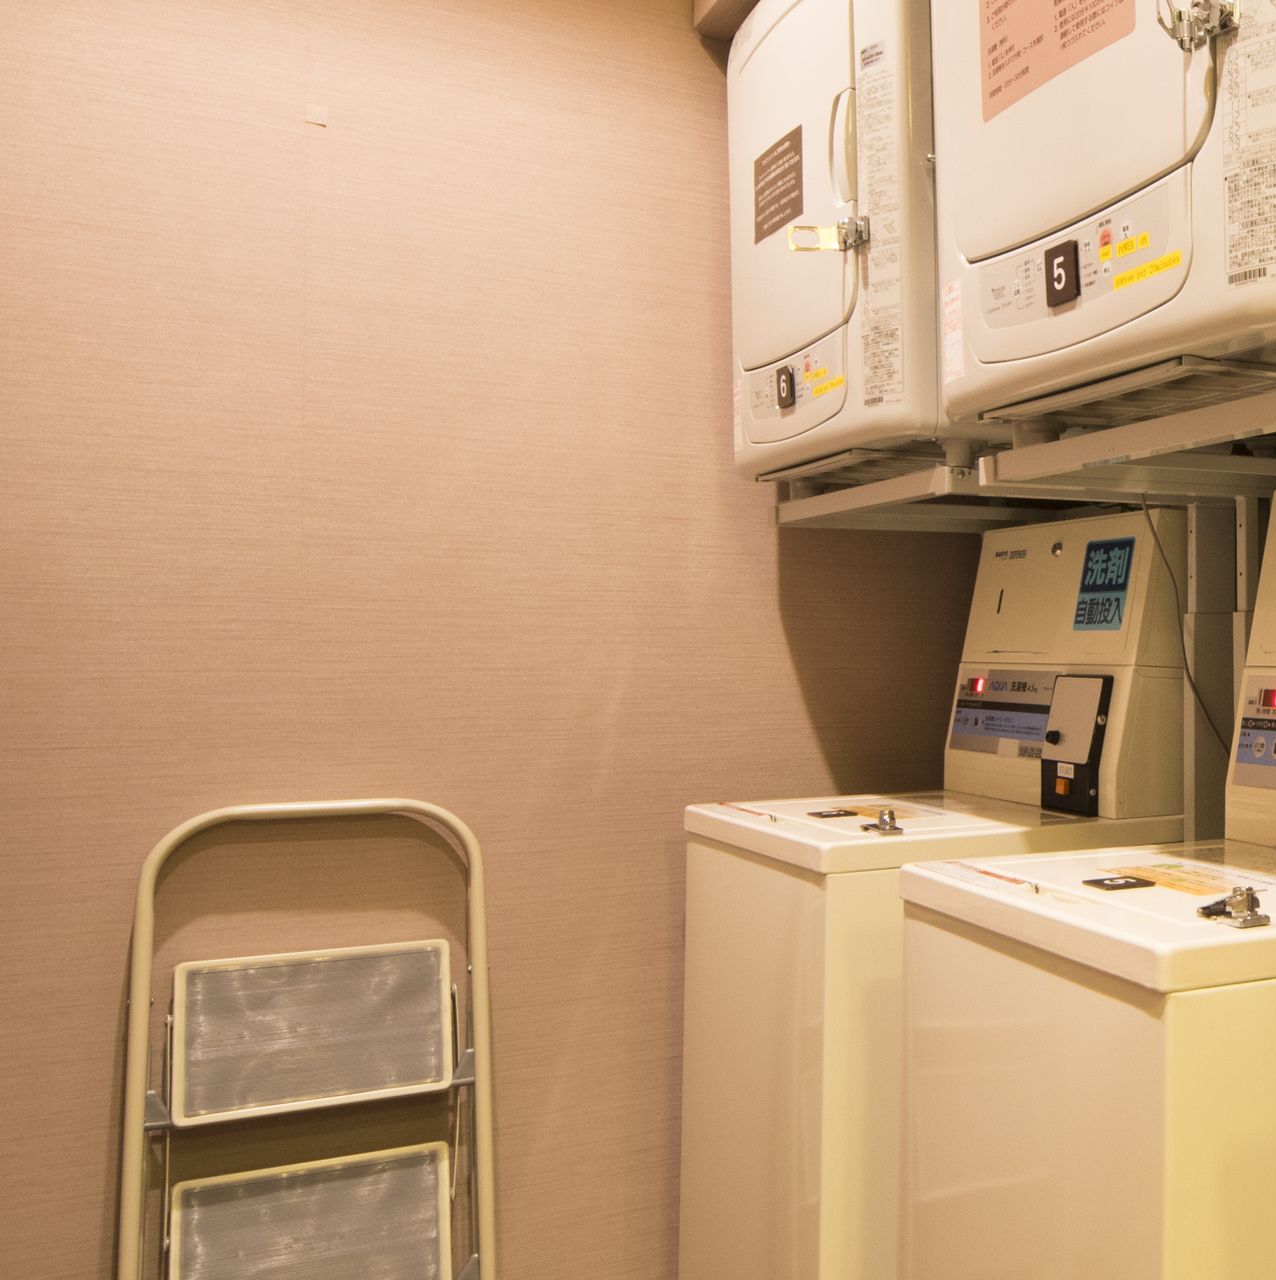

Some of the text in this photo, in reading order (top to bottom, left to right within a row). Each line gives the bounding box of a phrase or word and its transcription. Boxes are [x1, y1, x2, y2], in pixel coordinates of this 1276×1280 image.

[1053, 256, 1066, 290] 5
[780, 374, 786, 398] 6
[1085, 547, 1129, 585] 洗剤
[1075, 597, 1122, 625] 自動投入
